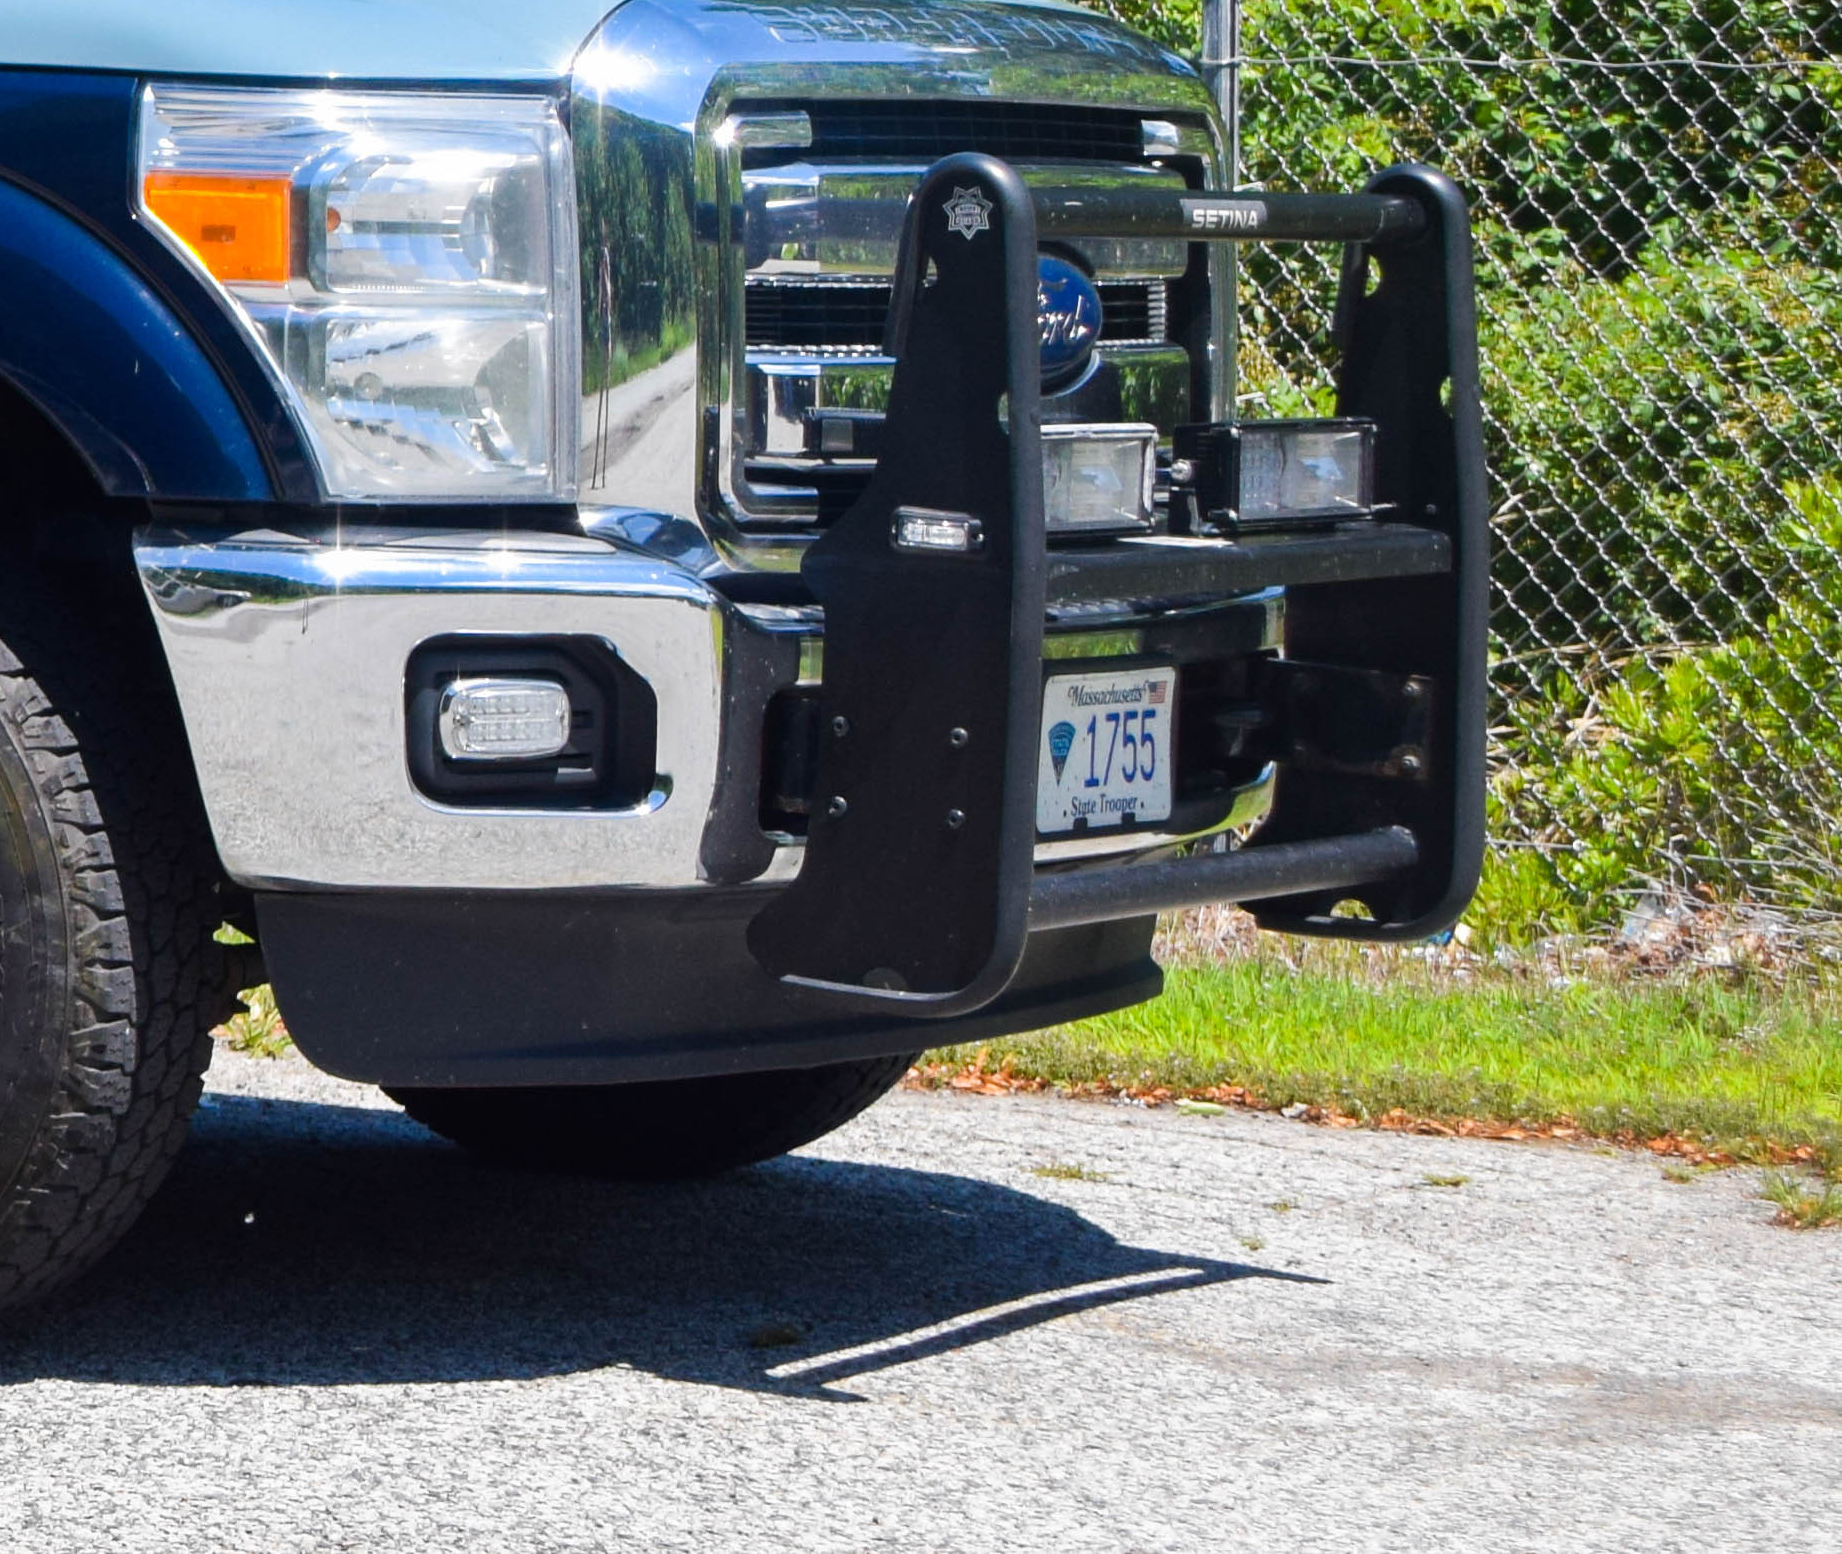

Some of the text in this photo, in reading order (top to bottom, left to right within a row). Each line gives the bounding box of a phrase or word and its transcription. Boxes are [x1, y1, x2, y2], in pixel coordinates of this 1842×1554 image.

[1191, 209, 1259, 229] SETINA
[1068, 680, 1149, 707] Massachusetts
[1084, 709, 1156, 788] 1755
[1070, 794, 1139, 817] State Trooper
